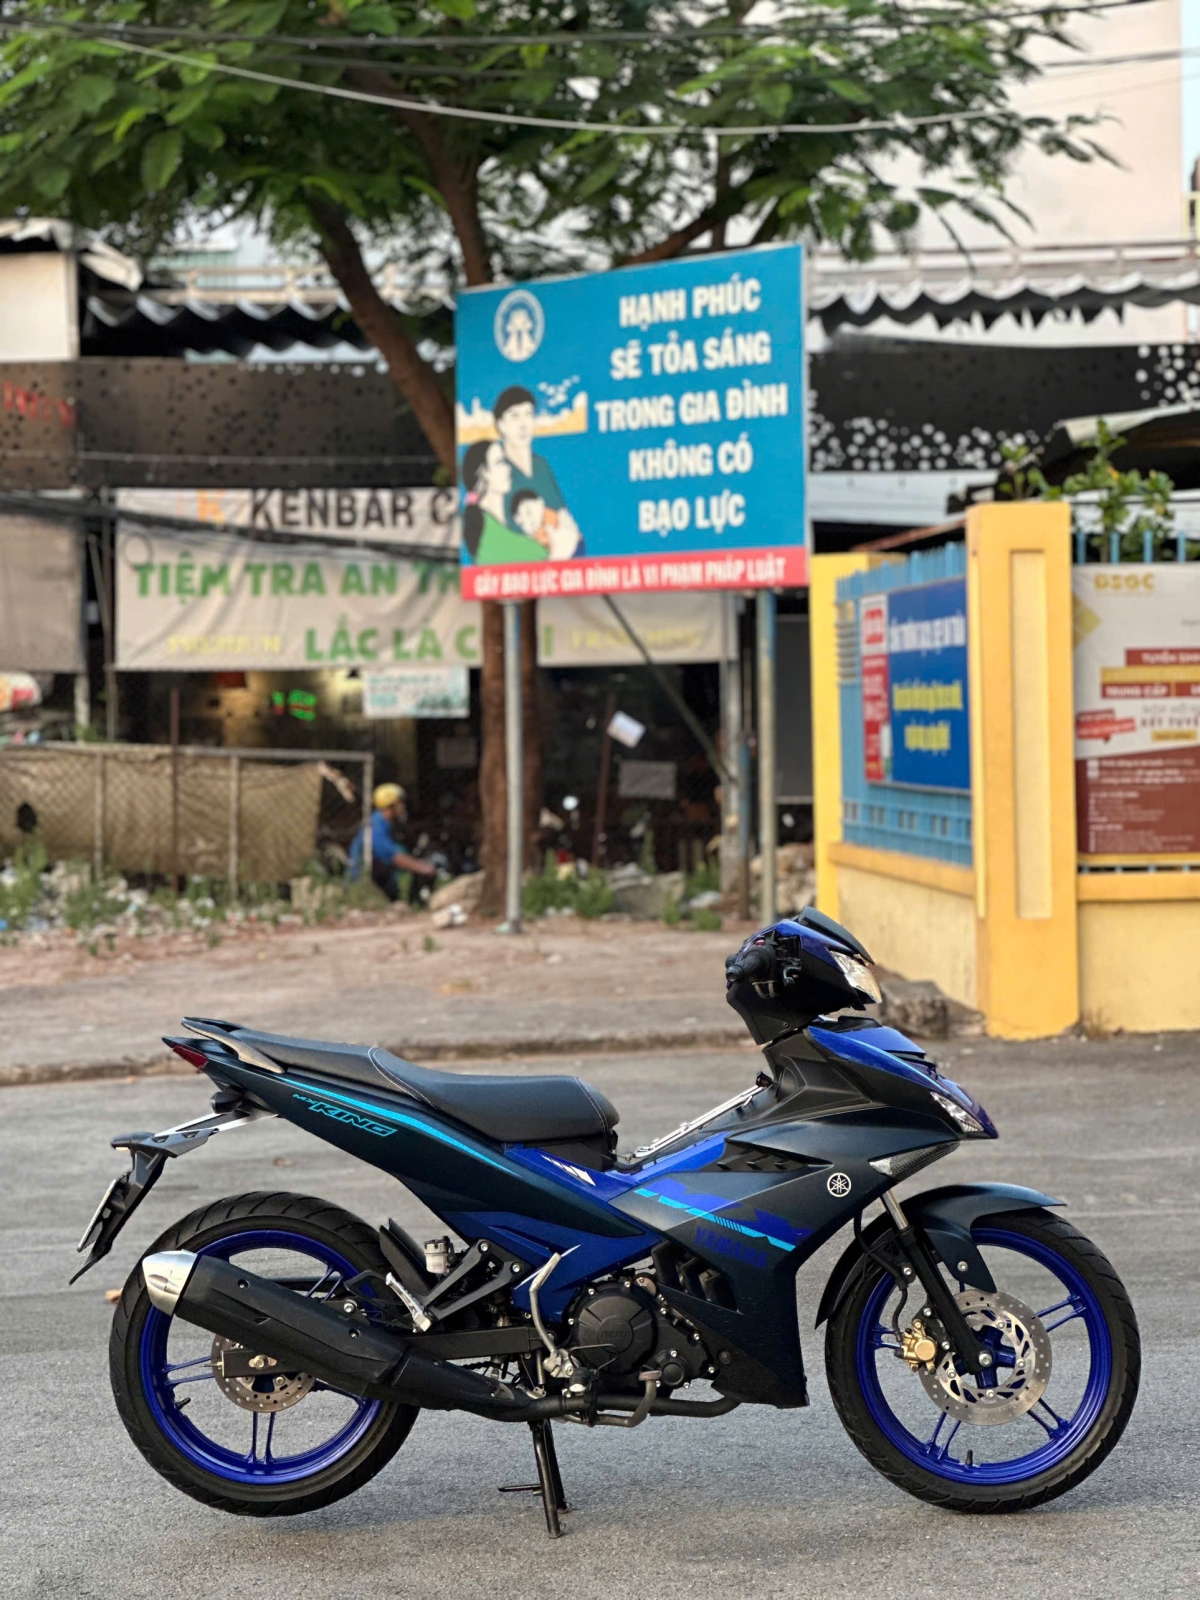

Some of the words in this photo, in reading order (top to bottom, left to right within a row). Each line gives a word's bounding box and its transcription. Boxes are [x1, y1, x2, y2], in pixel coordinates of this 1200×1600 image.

[619, 289, 687, 332] HẠNH
[692, 273, 761, 320] PHÚC
[610, 339, 643, 380] SẼ
[648, 330, 698, 376] TỎA
[703, 327, 771, 370] SÁNG
[595, 394, 675, 433] TRONG
[679, 390, 721, 425] GIA
[725, 379, 788, 421] ĐÌNH
[629, 438, 713, 482] KHÔNG
[717, 432, 753, 474] CÓ
[251, 488, 414, 530] KENBAR
[638, 497, 690, 538] BẠO
[695, 489, 746, 535] LỰC
[133, 550, 231, 605] TIỆM
[621, 559, 641, 589] LÀ
[746, 551, 786, 586] LUẬT
[308, 1101, 398, 1137] KING
[695, 1226, 769, 1269] YAMAHA
